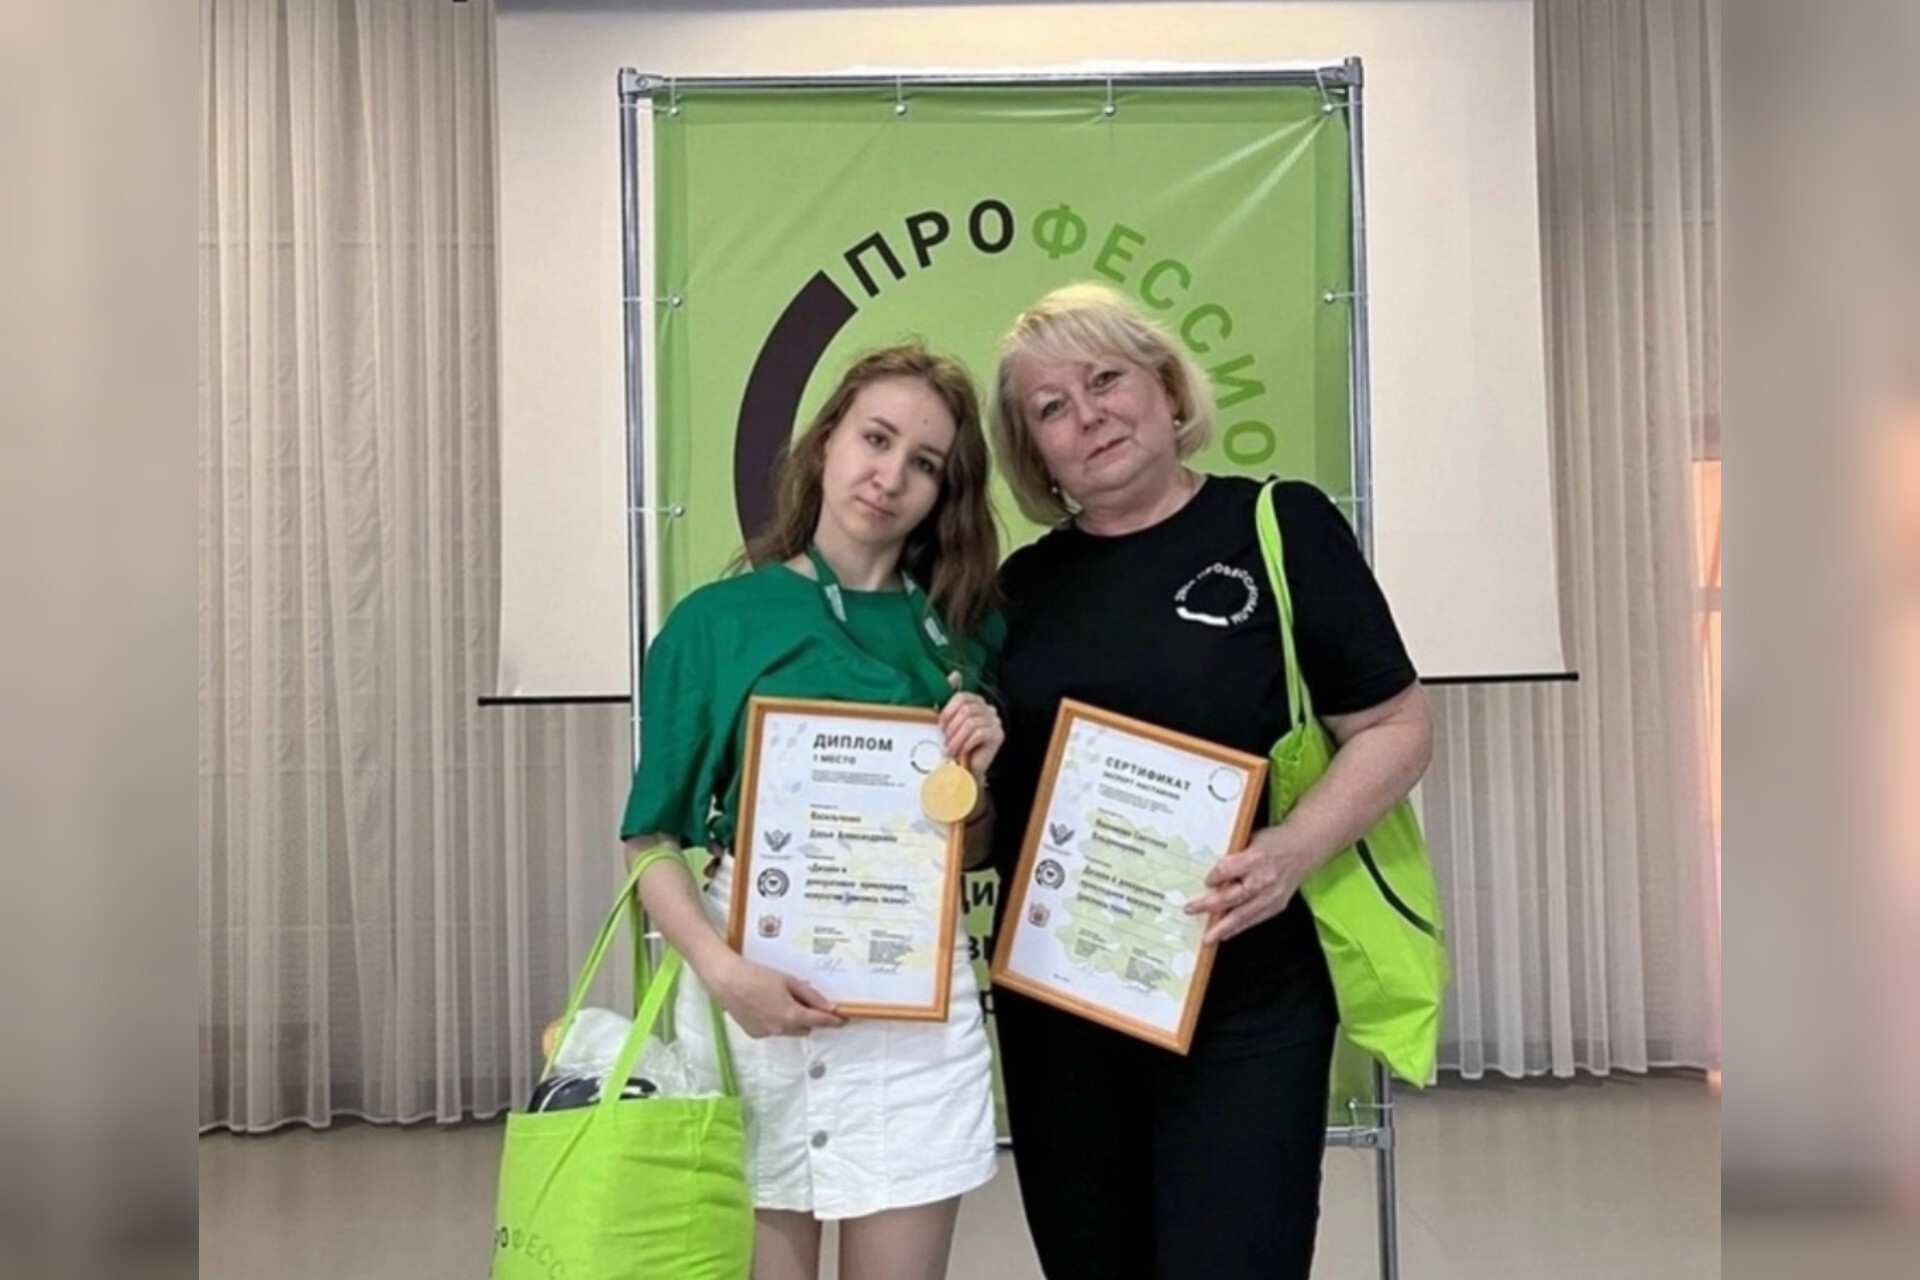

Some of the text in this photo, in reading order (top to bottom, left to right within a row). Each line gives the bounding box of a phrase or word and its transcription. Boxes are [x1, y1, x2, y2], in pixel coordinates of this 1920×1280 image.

[812, 733, 894, 752] ДИПЛОМ
[820, 754, 857, 765] МЕСТО
[1104, 756, 1191, 791] СЕРТИФИКАТ
